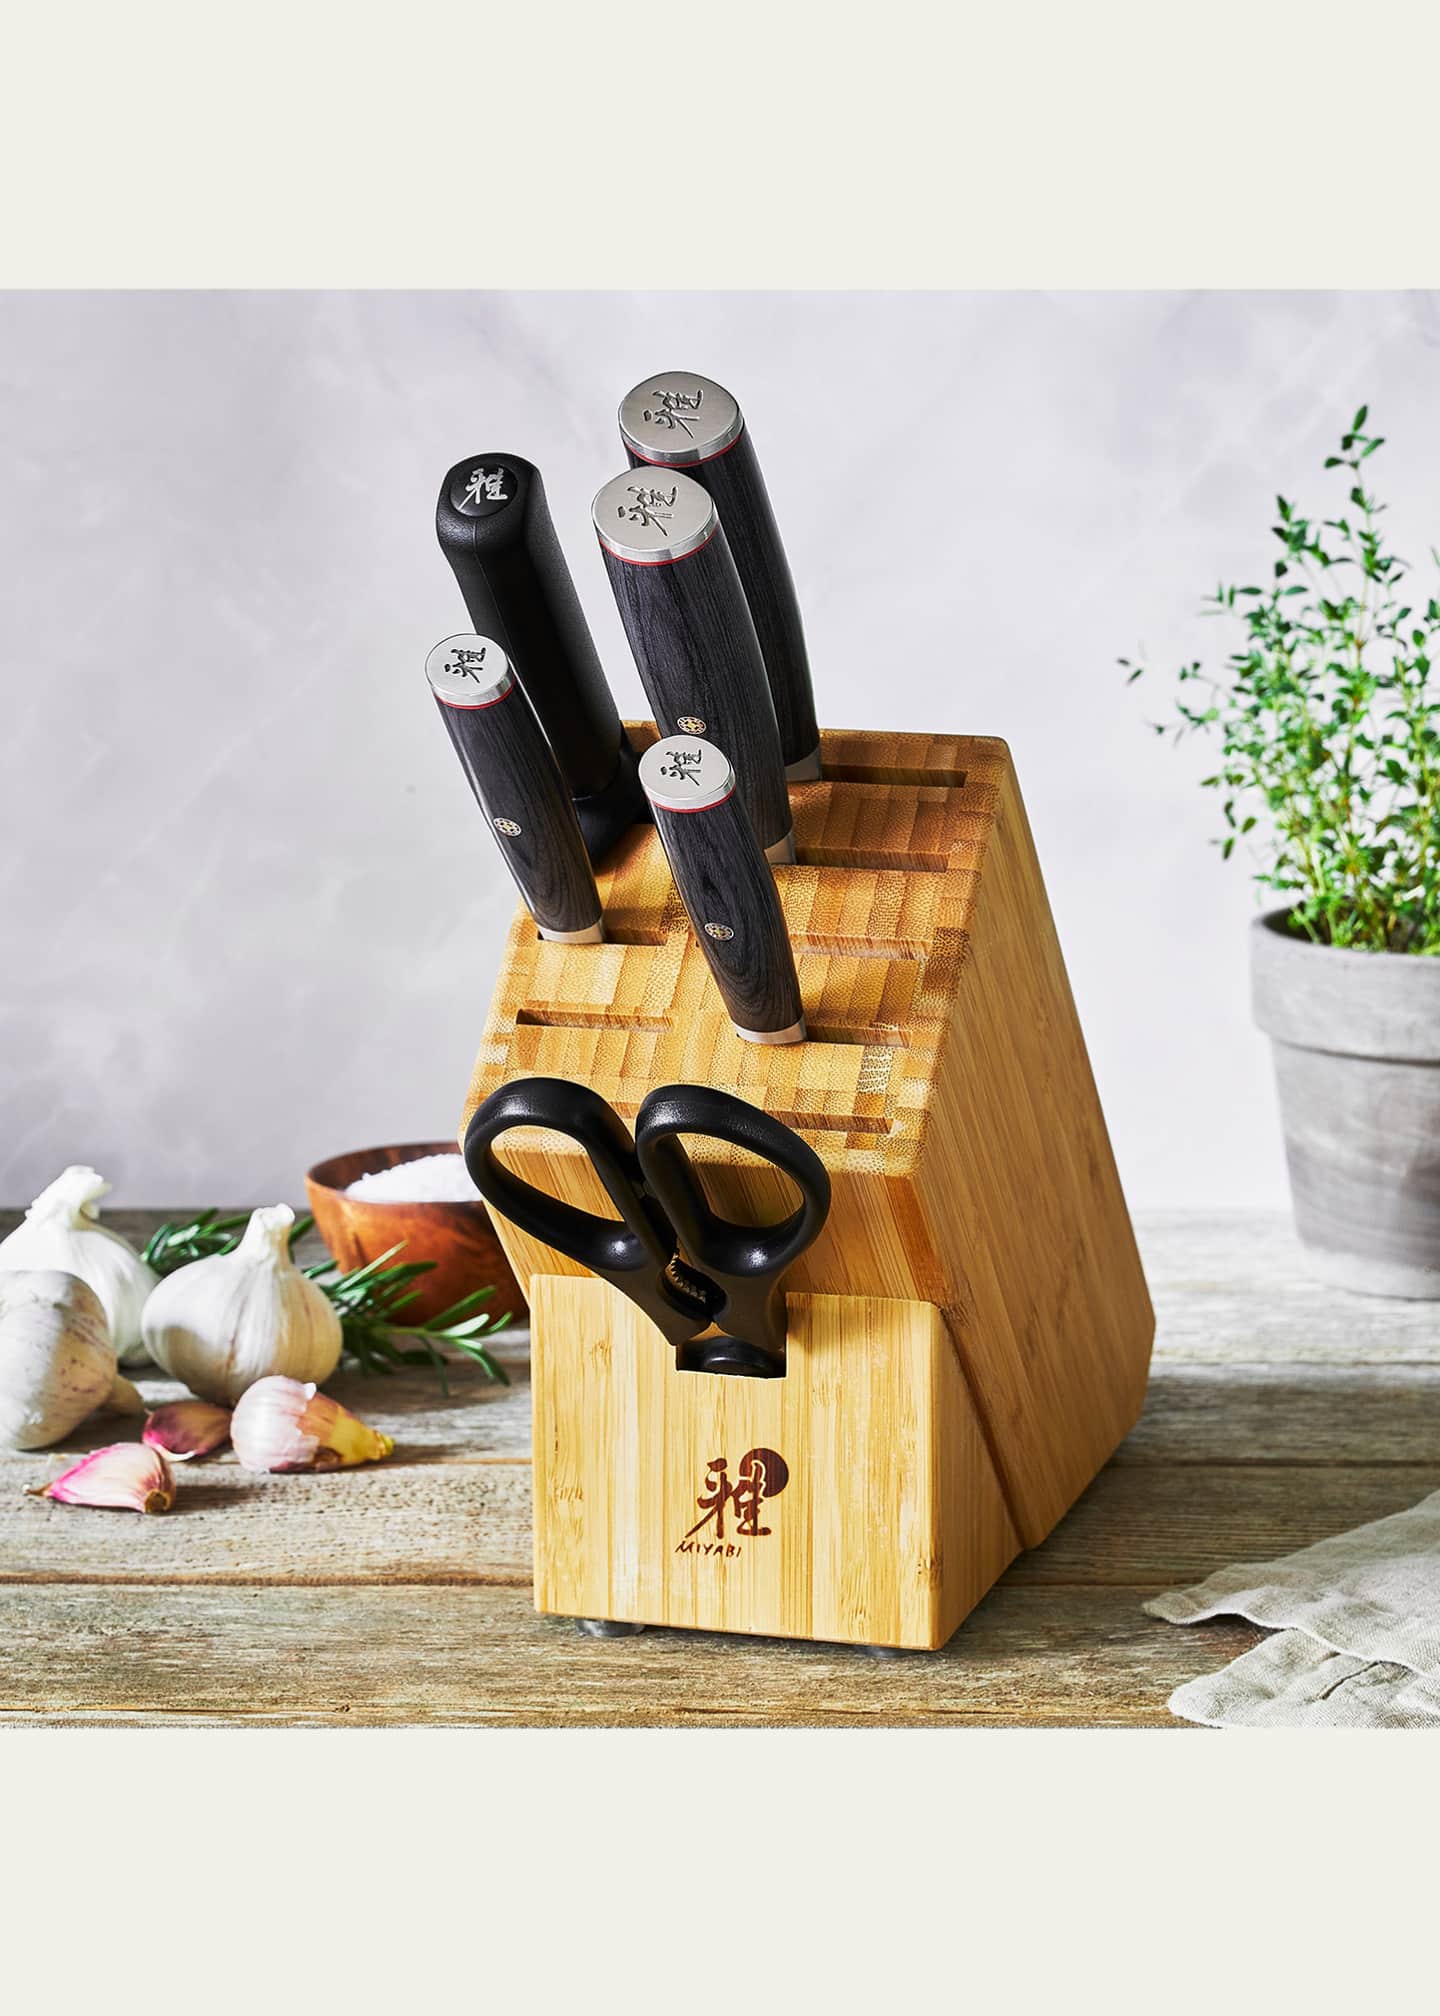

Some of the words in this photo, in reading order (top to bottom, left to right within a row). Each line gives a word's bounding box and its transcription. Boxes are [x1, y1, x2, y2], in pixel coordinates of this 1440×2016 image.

[459, 467, 508, 509] 雅
[684, 1456, 772, 1539] 雅
[674, 1539, 742, 1558] MIYABI
